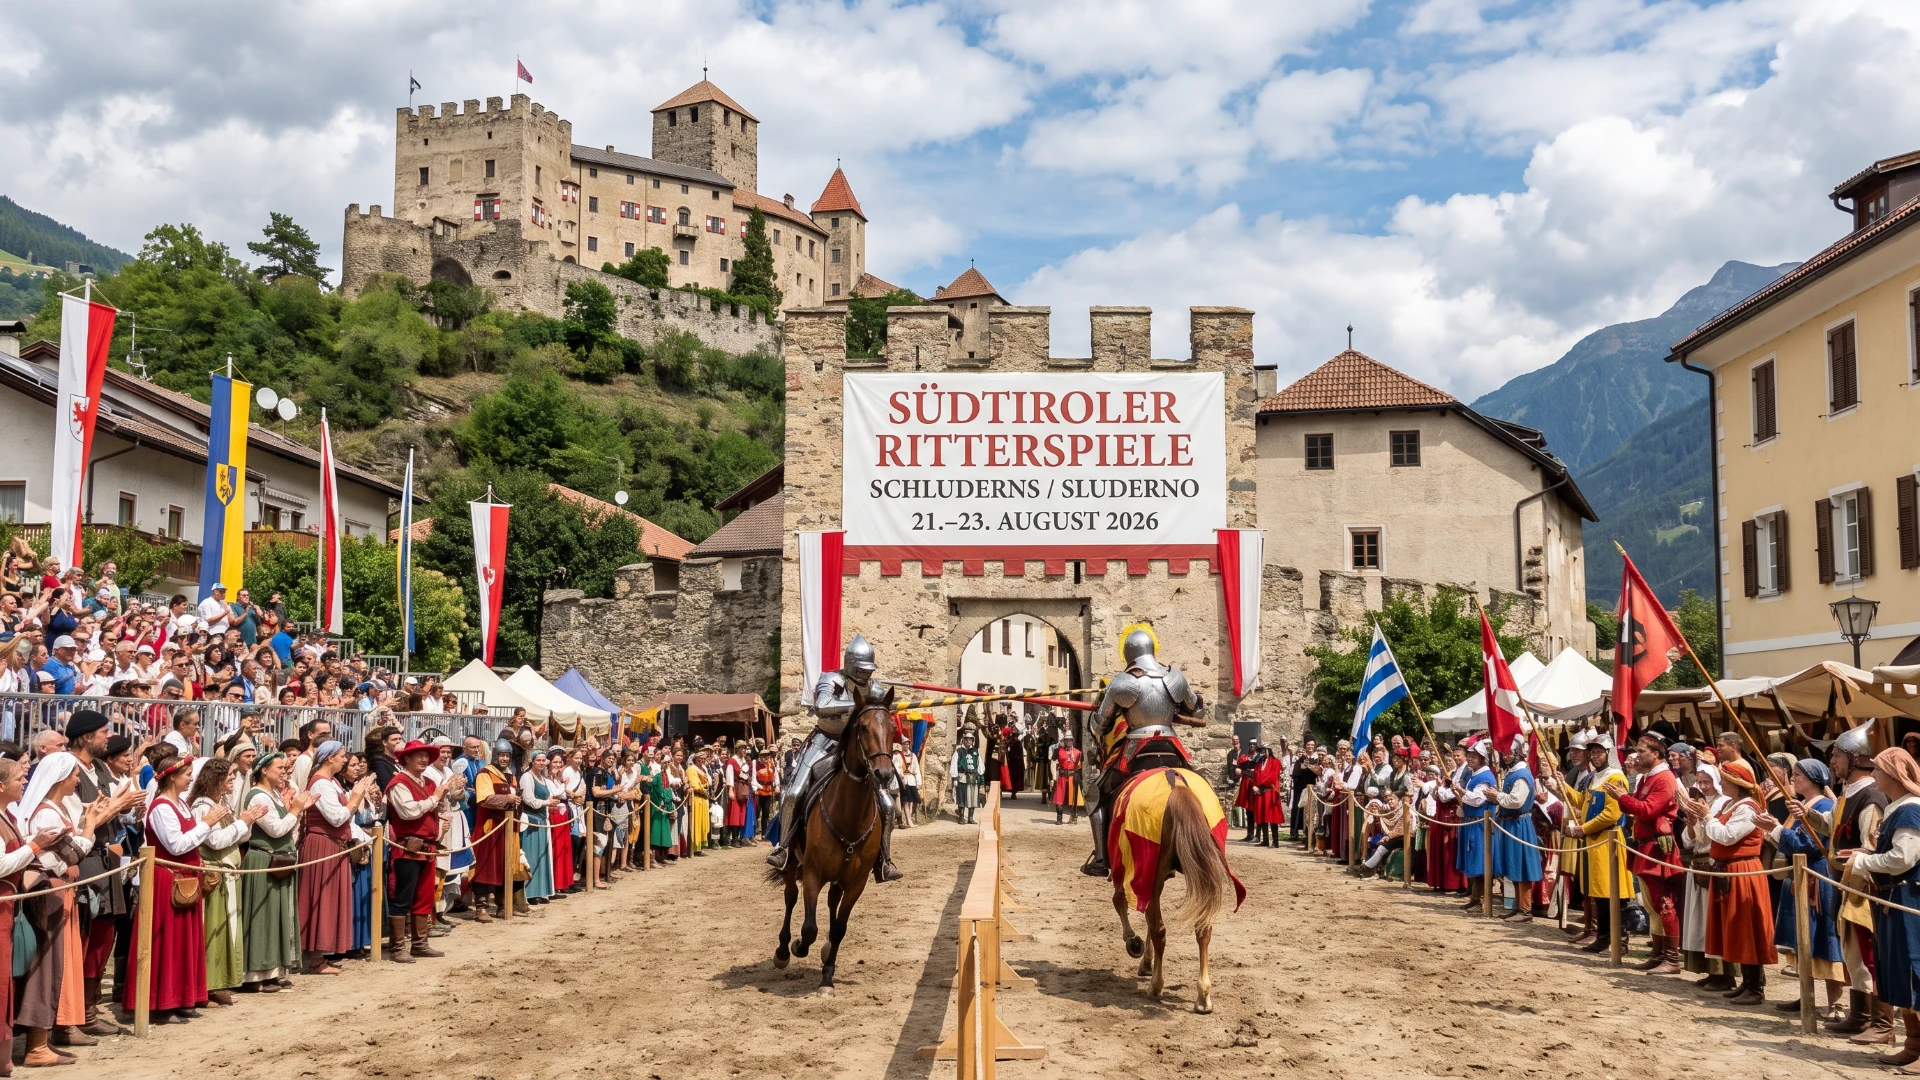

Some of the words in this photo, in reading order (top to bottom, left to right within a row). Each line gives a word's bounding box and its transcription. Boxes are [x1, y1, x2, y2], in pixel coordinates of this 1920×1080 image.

[889, 382, 1181, 425] SÜDTIROLER
[875, 433, 1194, 468] RITTERSPIELE
[870, 478, 1040, 499] SCHLUDERNS
[1046, 479, 1055, 500] /
[1061, 478, 1200, 499] SLUDERNO
[911, 511, 991, 531] 21.–23.
[996, 511, 1100, 531] AUGUST
[1106, 511, 1159, 531] 2026
